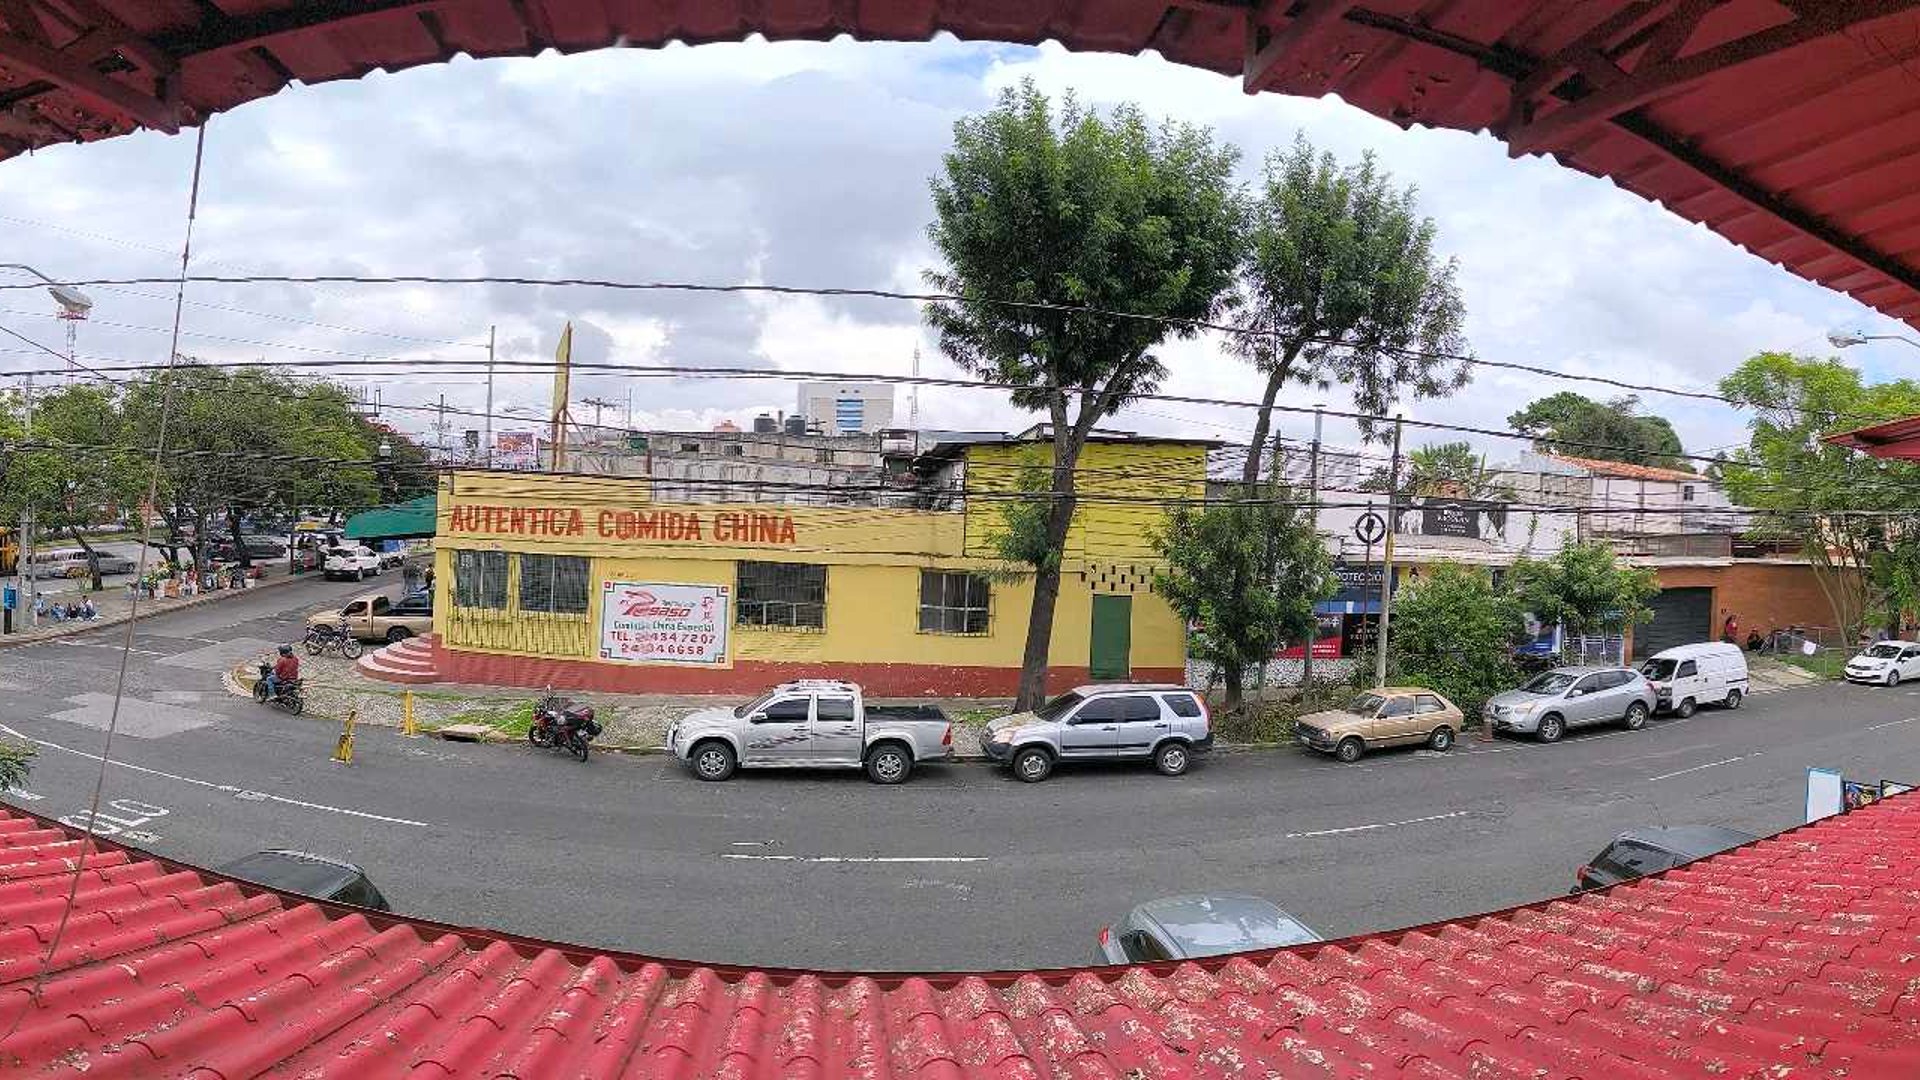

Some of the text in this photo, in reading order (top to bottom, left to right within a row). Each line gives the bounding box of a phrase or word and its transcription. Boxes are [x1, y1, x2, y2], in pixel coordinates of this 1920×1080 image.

[450, 505, 796, 543] AUTENTICA COMIDA CHINA
